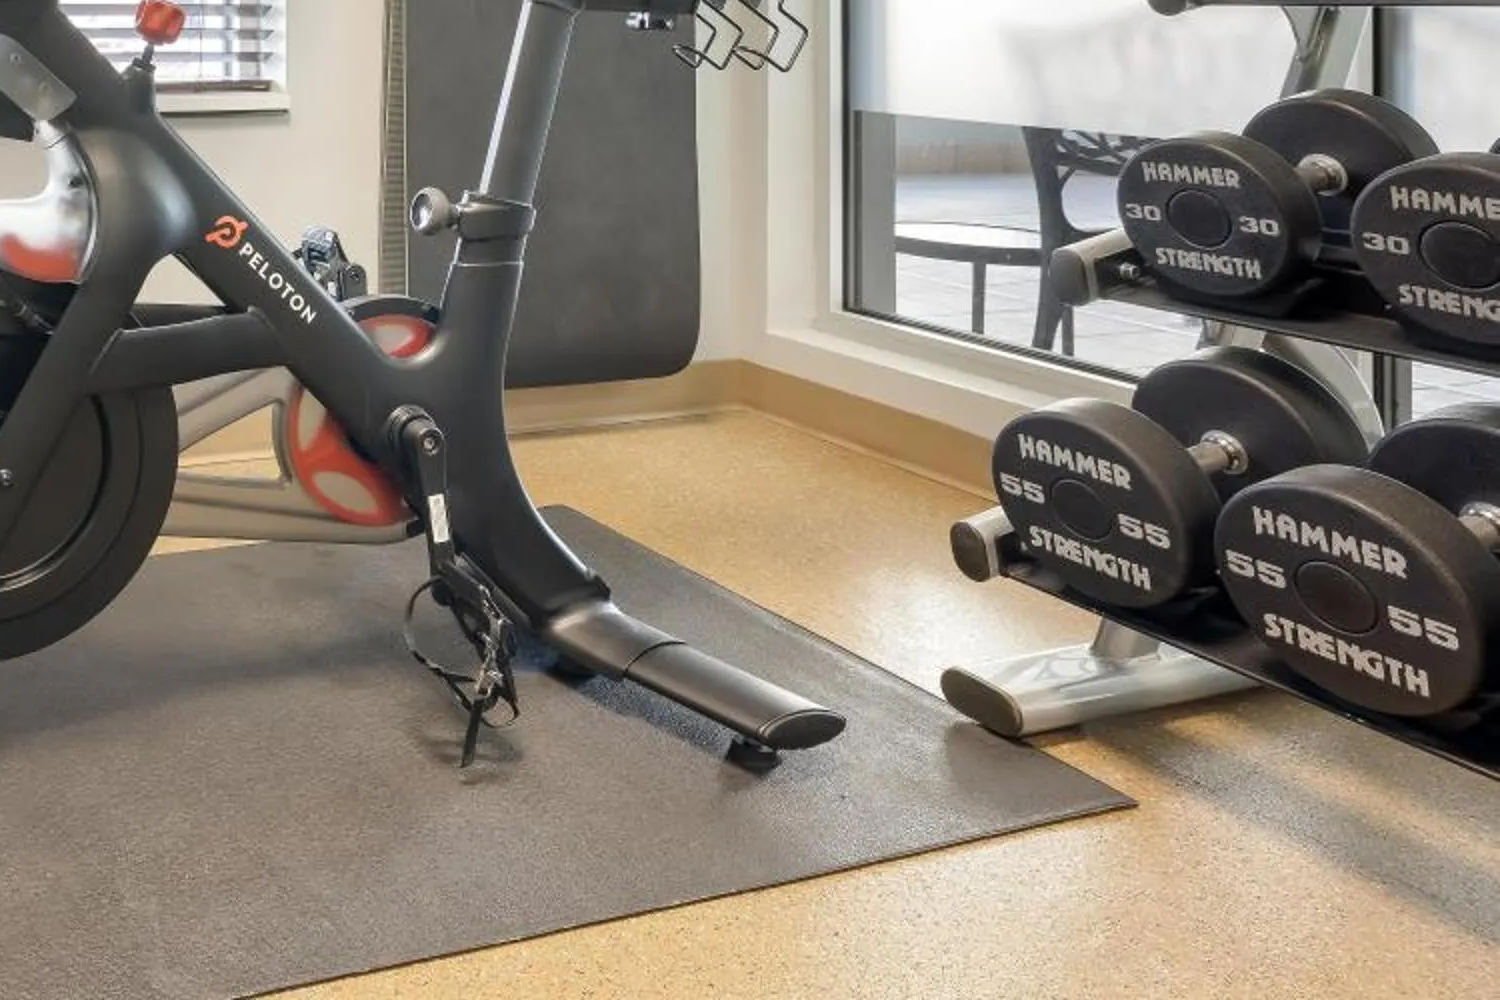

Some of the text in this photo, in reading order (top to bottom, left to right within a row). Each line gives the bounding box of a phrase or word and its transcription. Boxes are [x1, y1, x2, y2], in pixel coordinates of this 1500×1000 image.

[1140, 160, 1242, 190] HAMMER
[1389, 184, 1500, 221] HAMME
[1124, 202, 1280, 238] 30 30
[1361, 231, 1410, 255] 30
[238, 241, 317, 324] PELOTON
[1155, 247, 1263, 281] STRENGTH
[1396, 283, 1500, 324] STRENG
[1017, 433, 1133, 491] HAMMER
[1000, 471, 1171, 549] 55 55
[1029, 524, 1152, 592] STRENGTH
[1252, 505, 1409, 580] HAMMER
[1225, 549, 1460, 651] 55 55
[1263, 613, 1431, 698] STRENGTH
